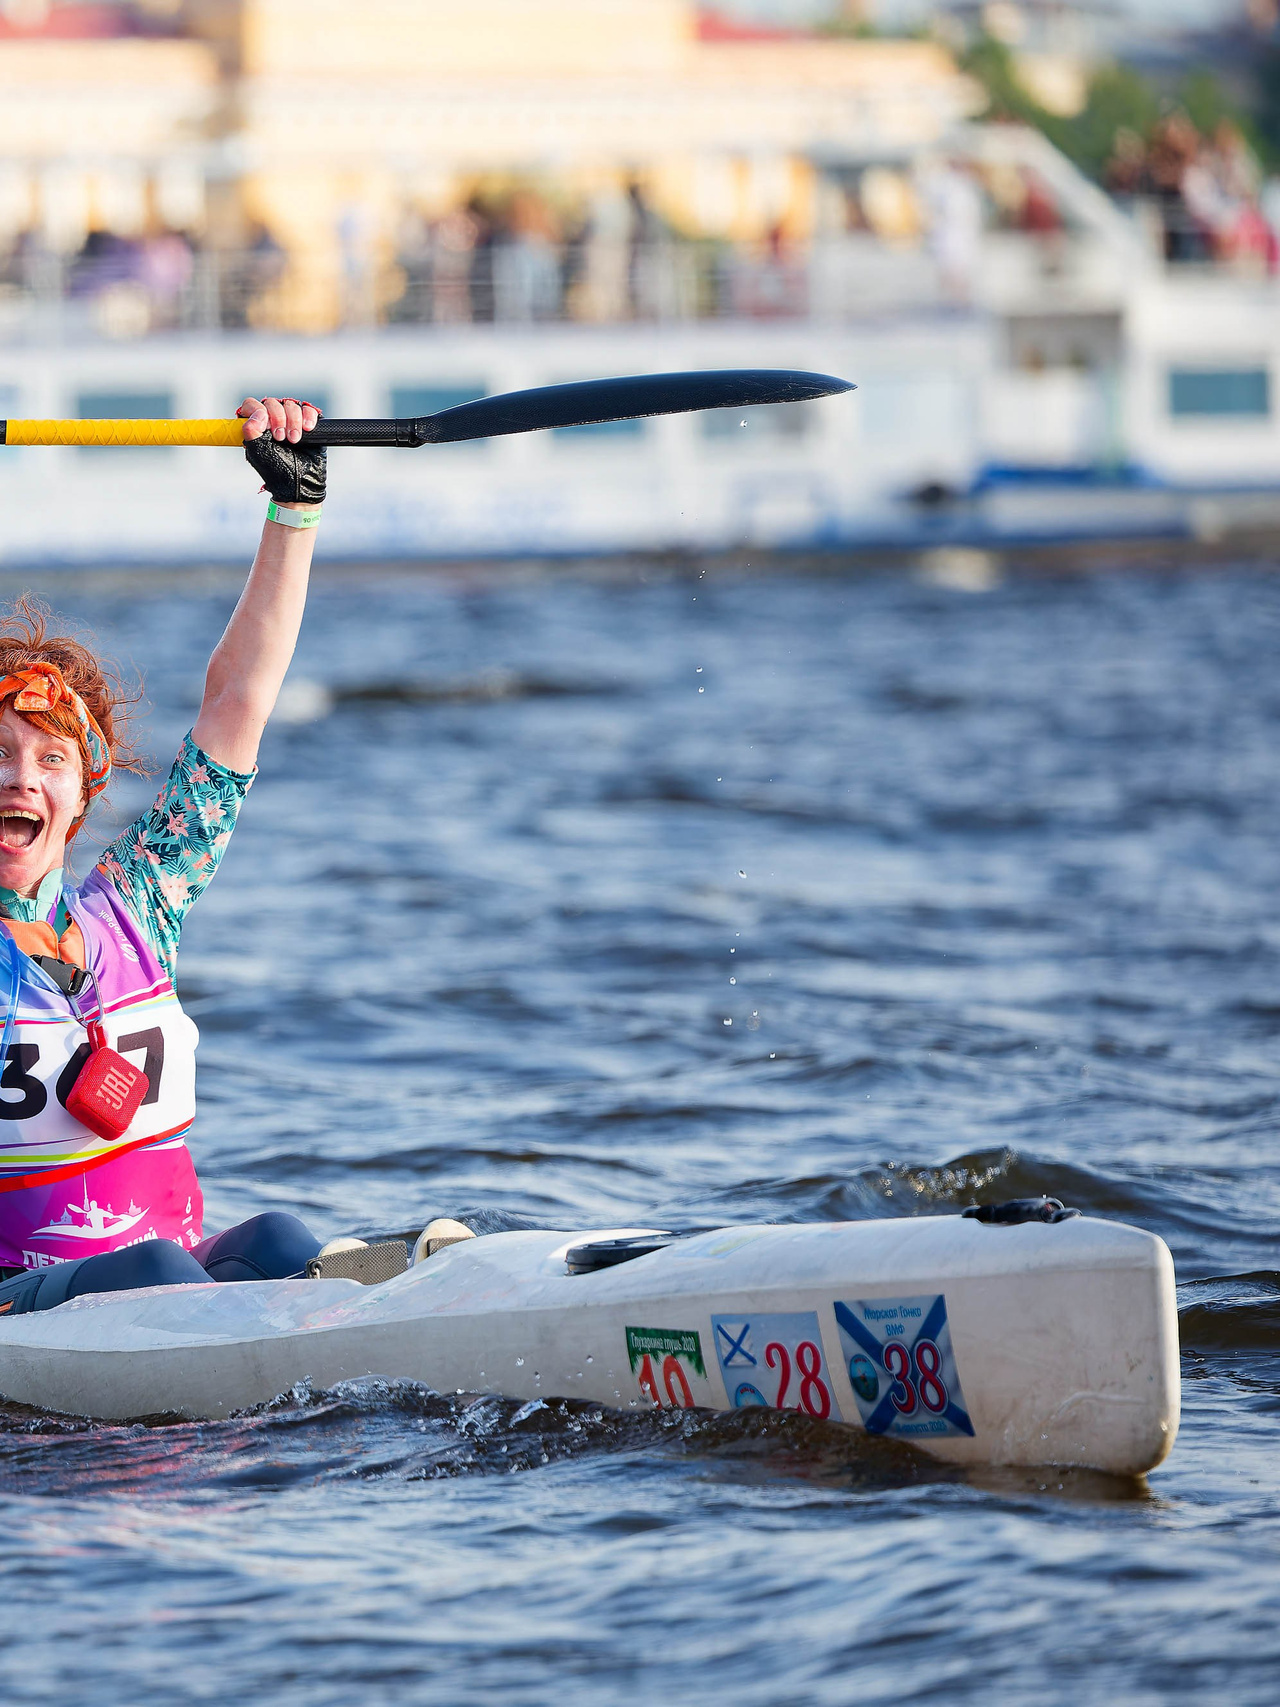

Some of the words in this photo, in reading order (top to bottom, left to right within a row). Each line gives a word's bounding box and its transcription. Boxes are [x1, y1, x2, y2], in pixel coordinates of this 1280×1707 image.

[99, 1066, 137, 1110] JBL
[864, 1307, 898, 1321] Морская
[886, 1323, 905, 1336] ВМФ
[638, 1353, 695, 1409] 10
[765, 1340, 831, 1419] 28
[883, 1340, 949, 1417] 38
